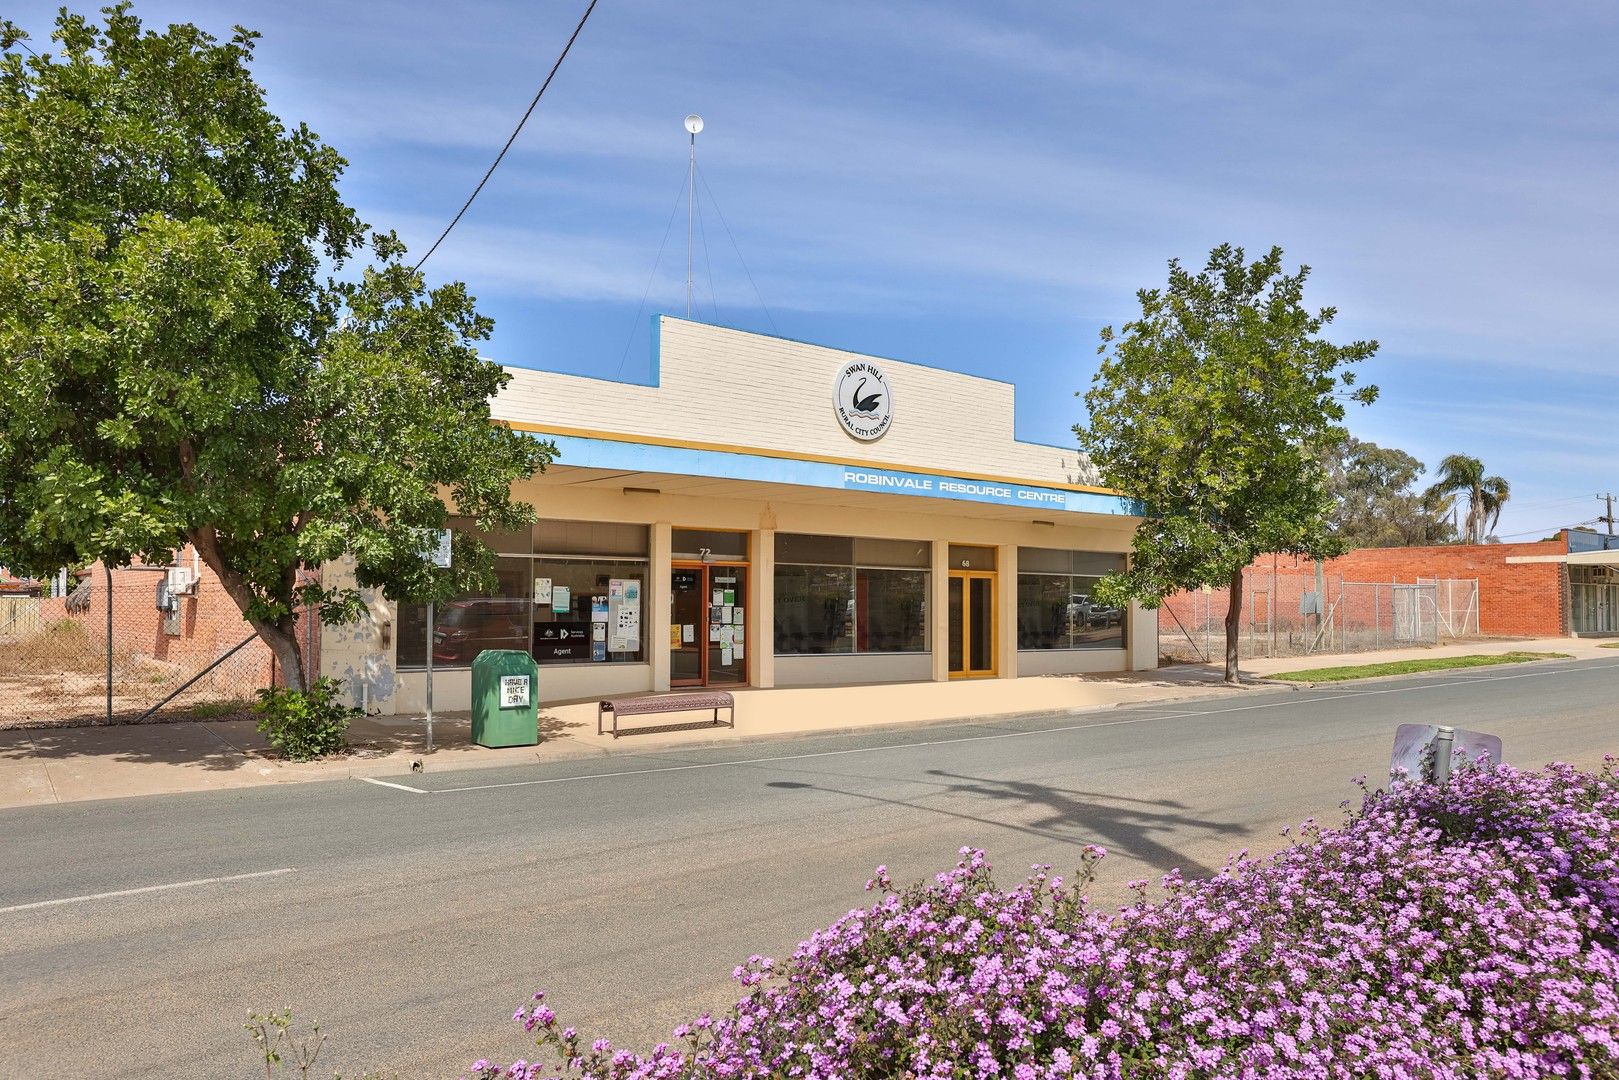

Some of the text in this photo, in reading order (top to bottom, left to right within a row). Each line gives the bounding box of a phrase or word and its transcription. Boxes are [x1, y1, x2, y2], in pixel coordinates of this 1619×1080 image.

[845, 363, 883, 383] SWAN HILL
[839, 407, 890, 436] RURAL CITY COUNCIL
[844, 472, 1065, 503] ROBINVALE RESOURCE CENTRE
[699, 548, 712, 556] 72
[961, 559, 970, 568] 68
[553, 648, 571, 656] Agent
[506, 686, 525, 694] NICE
[507, 695, 524, 704] DAY
